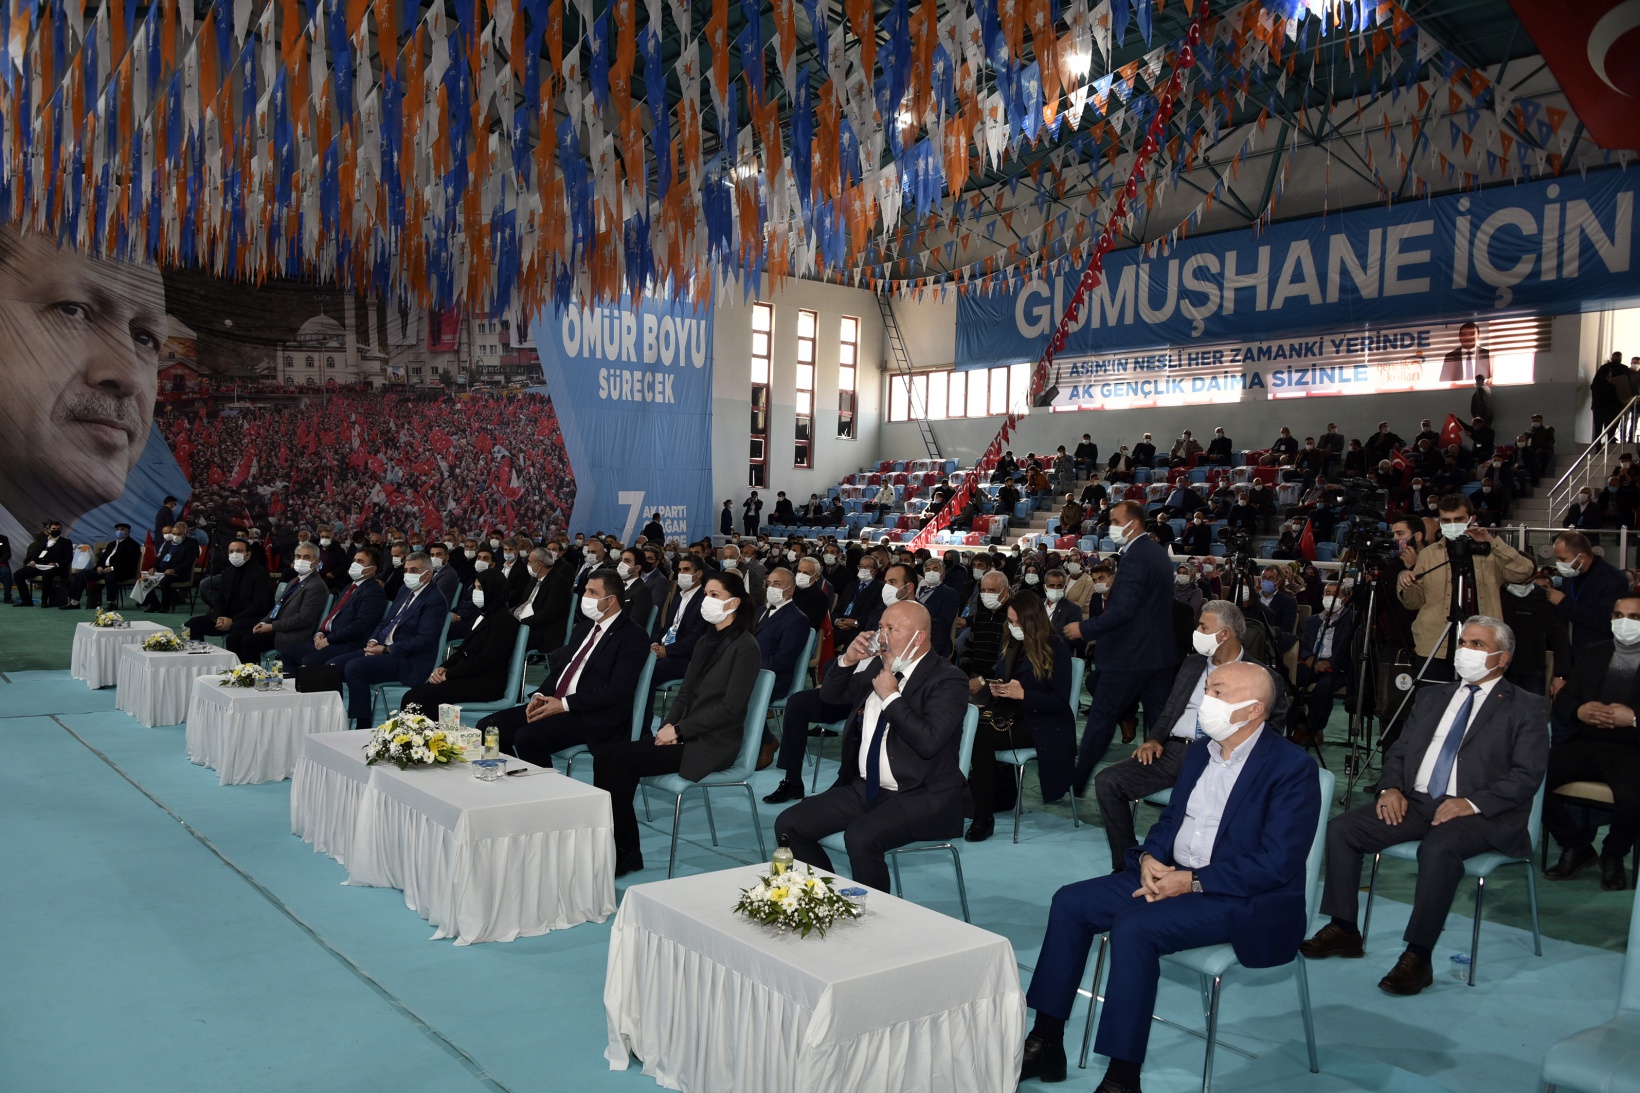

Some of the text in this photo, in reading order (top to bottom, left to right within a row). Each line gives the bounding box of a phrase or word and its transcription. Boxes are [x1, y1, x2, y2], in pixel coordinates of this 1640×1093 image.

[1015, 184, 1634, 339] GÜMÜŞHANE İÇİN
[643, 313, 706, 369] BOYU
[1133, 351, 1182, 372] NESLİ
[1188, 349, 1224, 367] HER
[1230, 337, 1324, 363] ZAMANKİ
[1331, 330, 1431, 355] YERİNDE
[599, 367, 675, 404] SÜRECEK
[1069, 363, 1368, 400] AK GENÇLİK DAİMA SİZİNLE
[617, 490, 646, 550] 7
[658, 505, 687, 518] PARTİ
